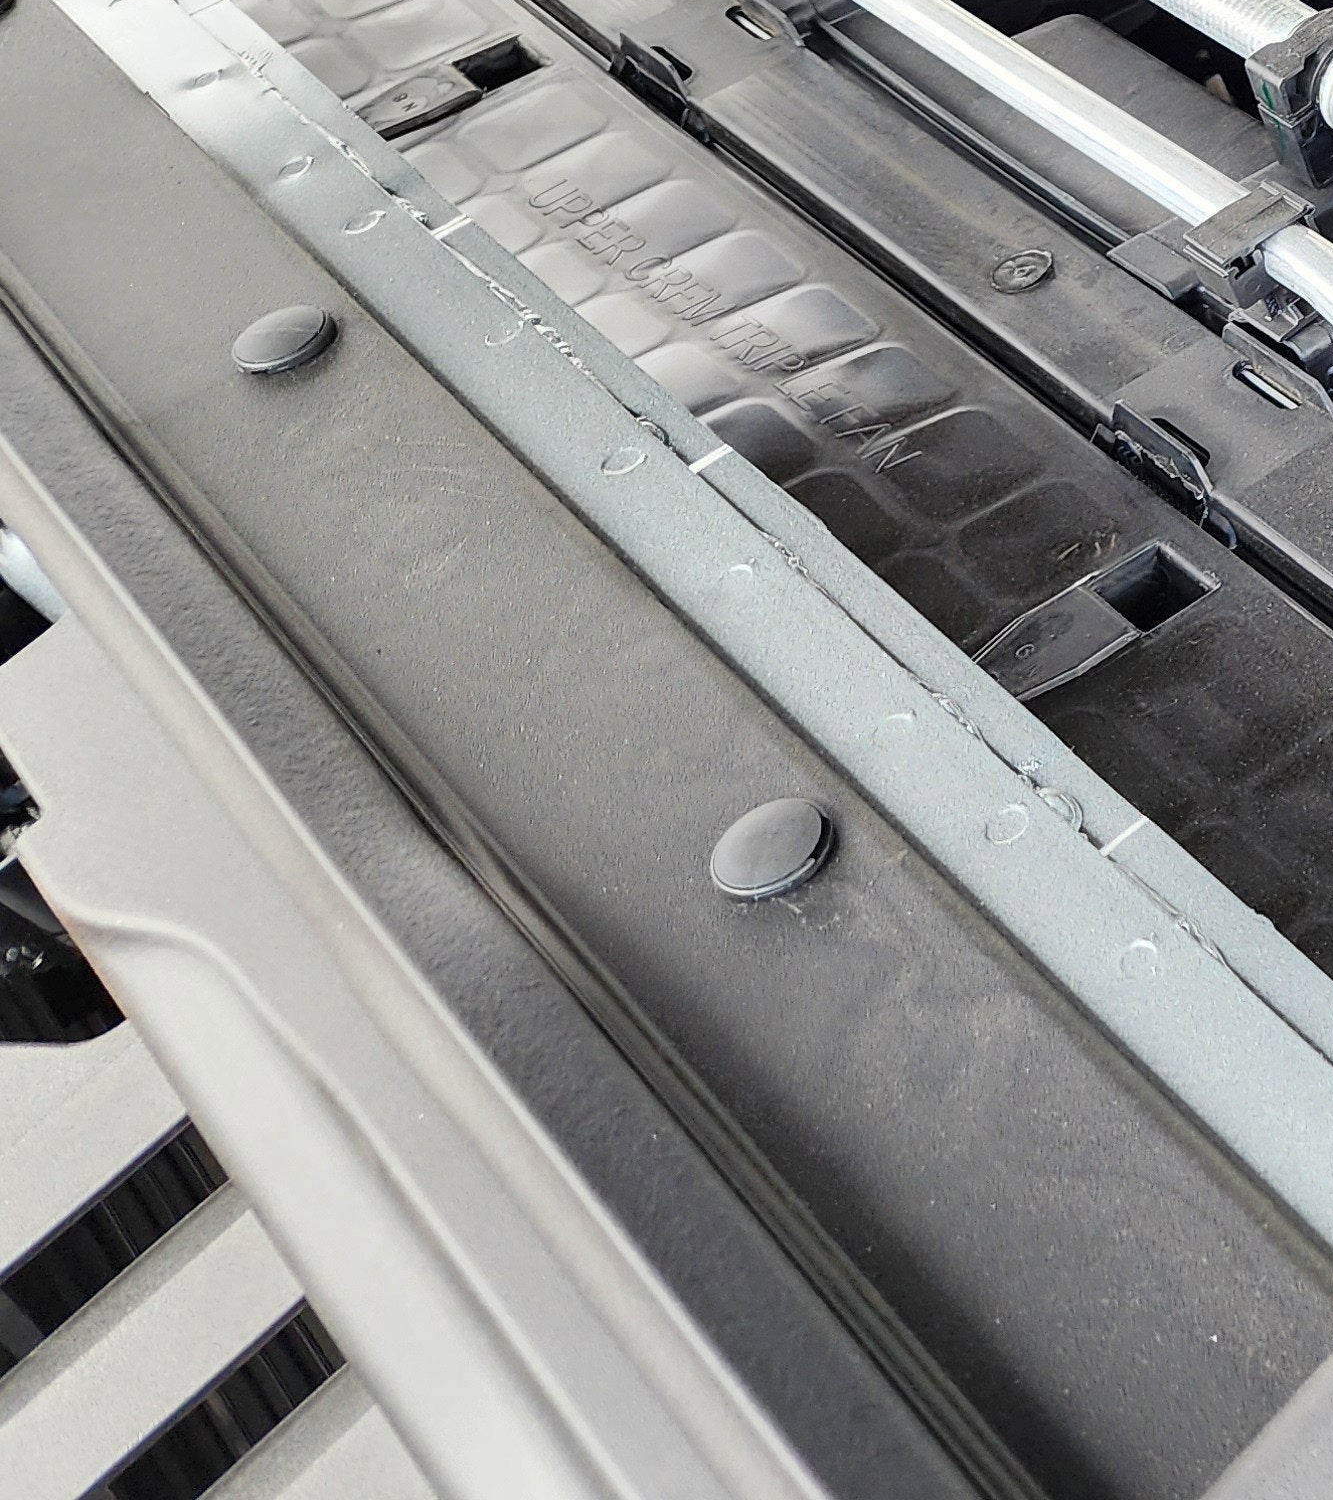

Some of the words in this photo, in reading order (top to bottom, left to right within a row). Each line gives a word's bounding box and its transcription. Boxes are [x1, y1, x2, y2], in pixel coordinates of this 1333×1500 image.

[528, 179, 646, 266] UPPER
[624, 255, 738, 328] CRFM
[710, 313, 852, 412] TRIPLE
[819, 402, 923, 474] FAN
